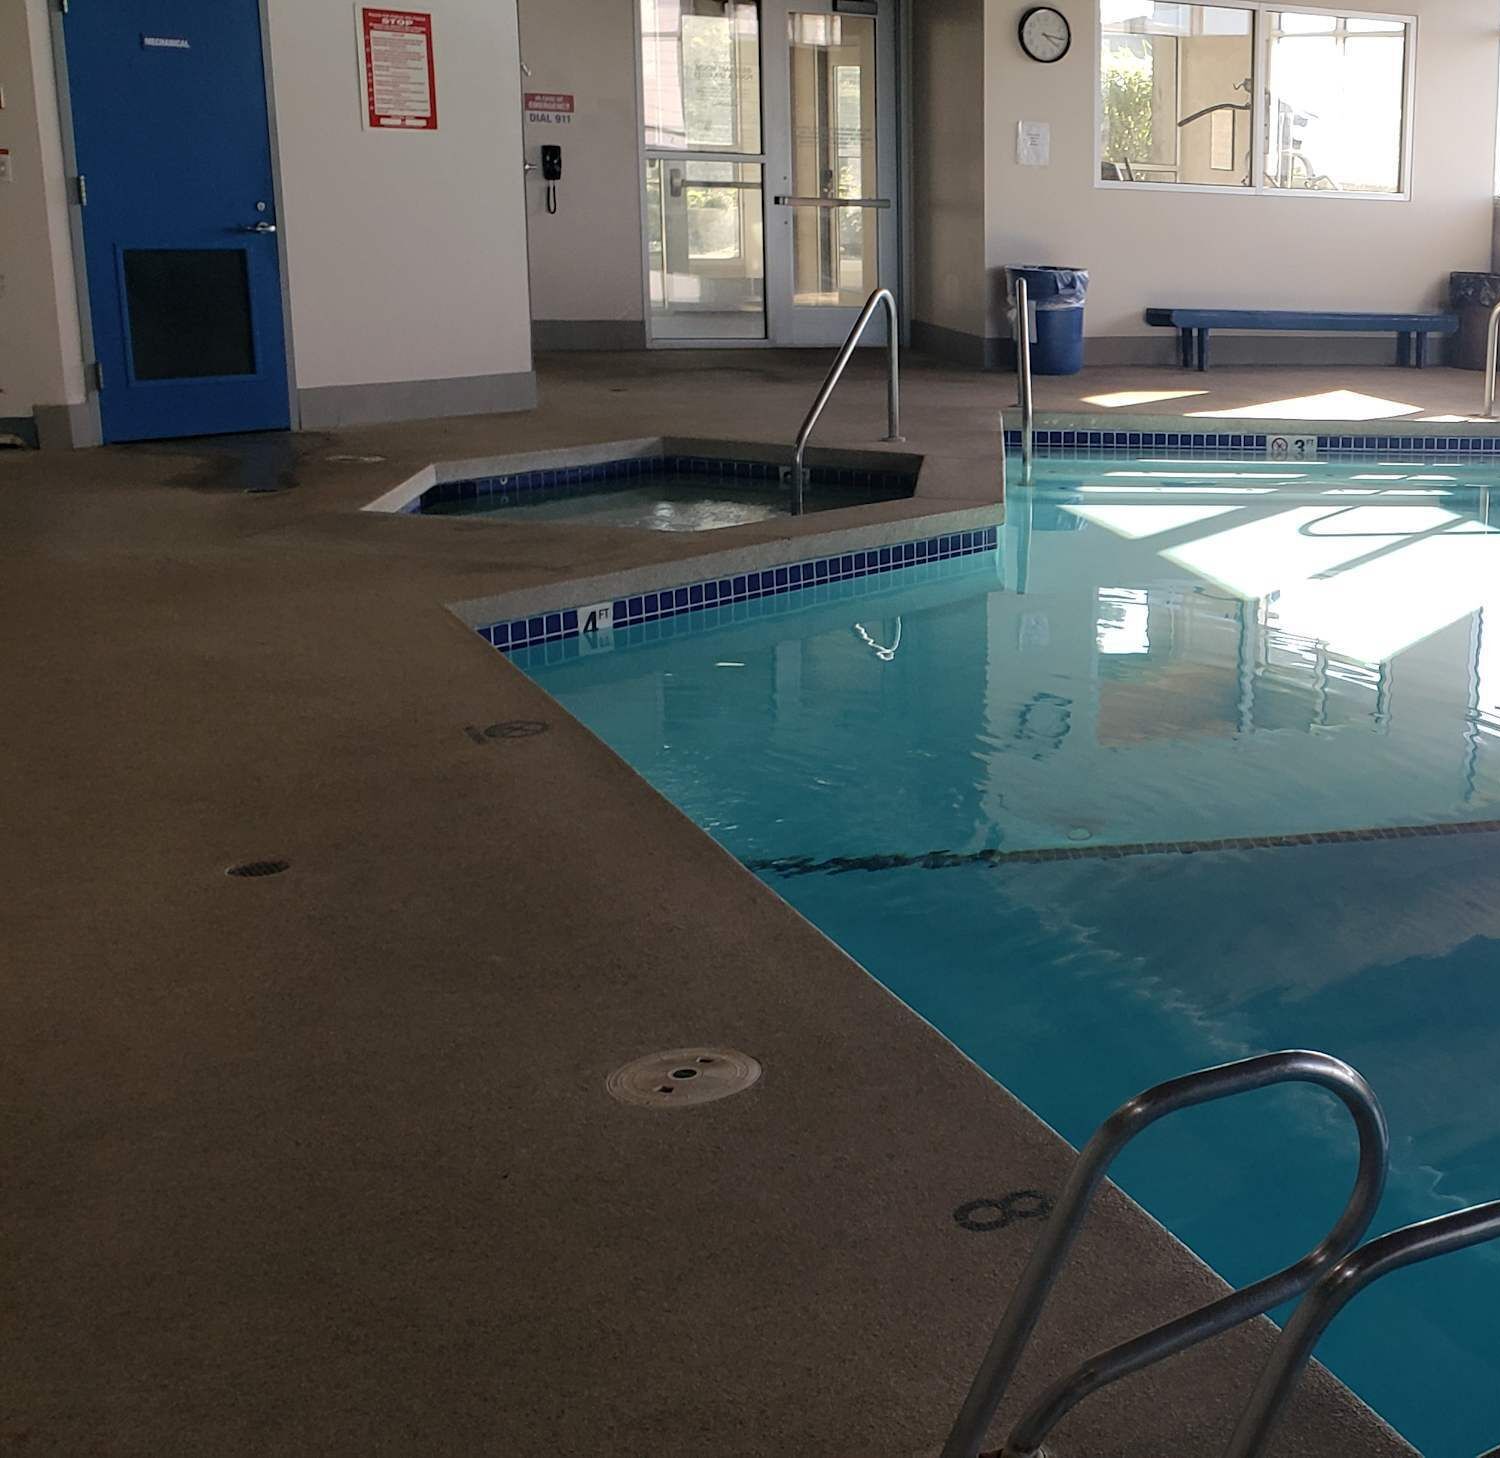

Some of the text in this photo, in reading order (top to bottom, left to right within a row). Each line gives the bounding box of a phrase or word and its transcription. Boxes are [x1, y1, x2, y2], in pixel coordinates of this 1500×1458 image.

[381, 17, 414, 27] STOP
[144, 37, 190, 48] MECHANICAL
[529, 113, 571, 124] DIAL 911
[1294, 439, 1305, 452] 3
[583, 608, 609, 633] 4 FT
